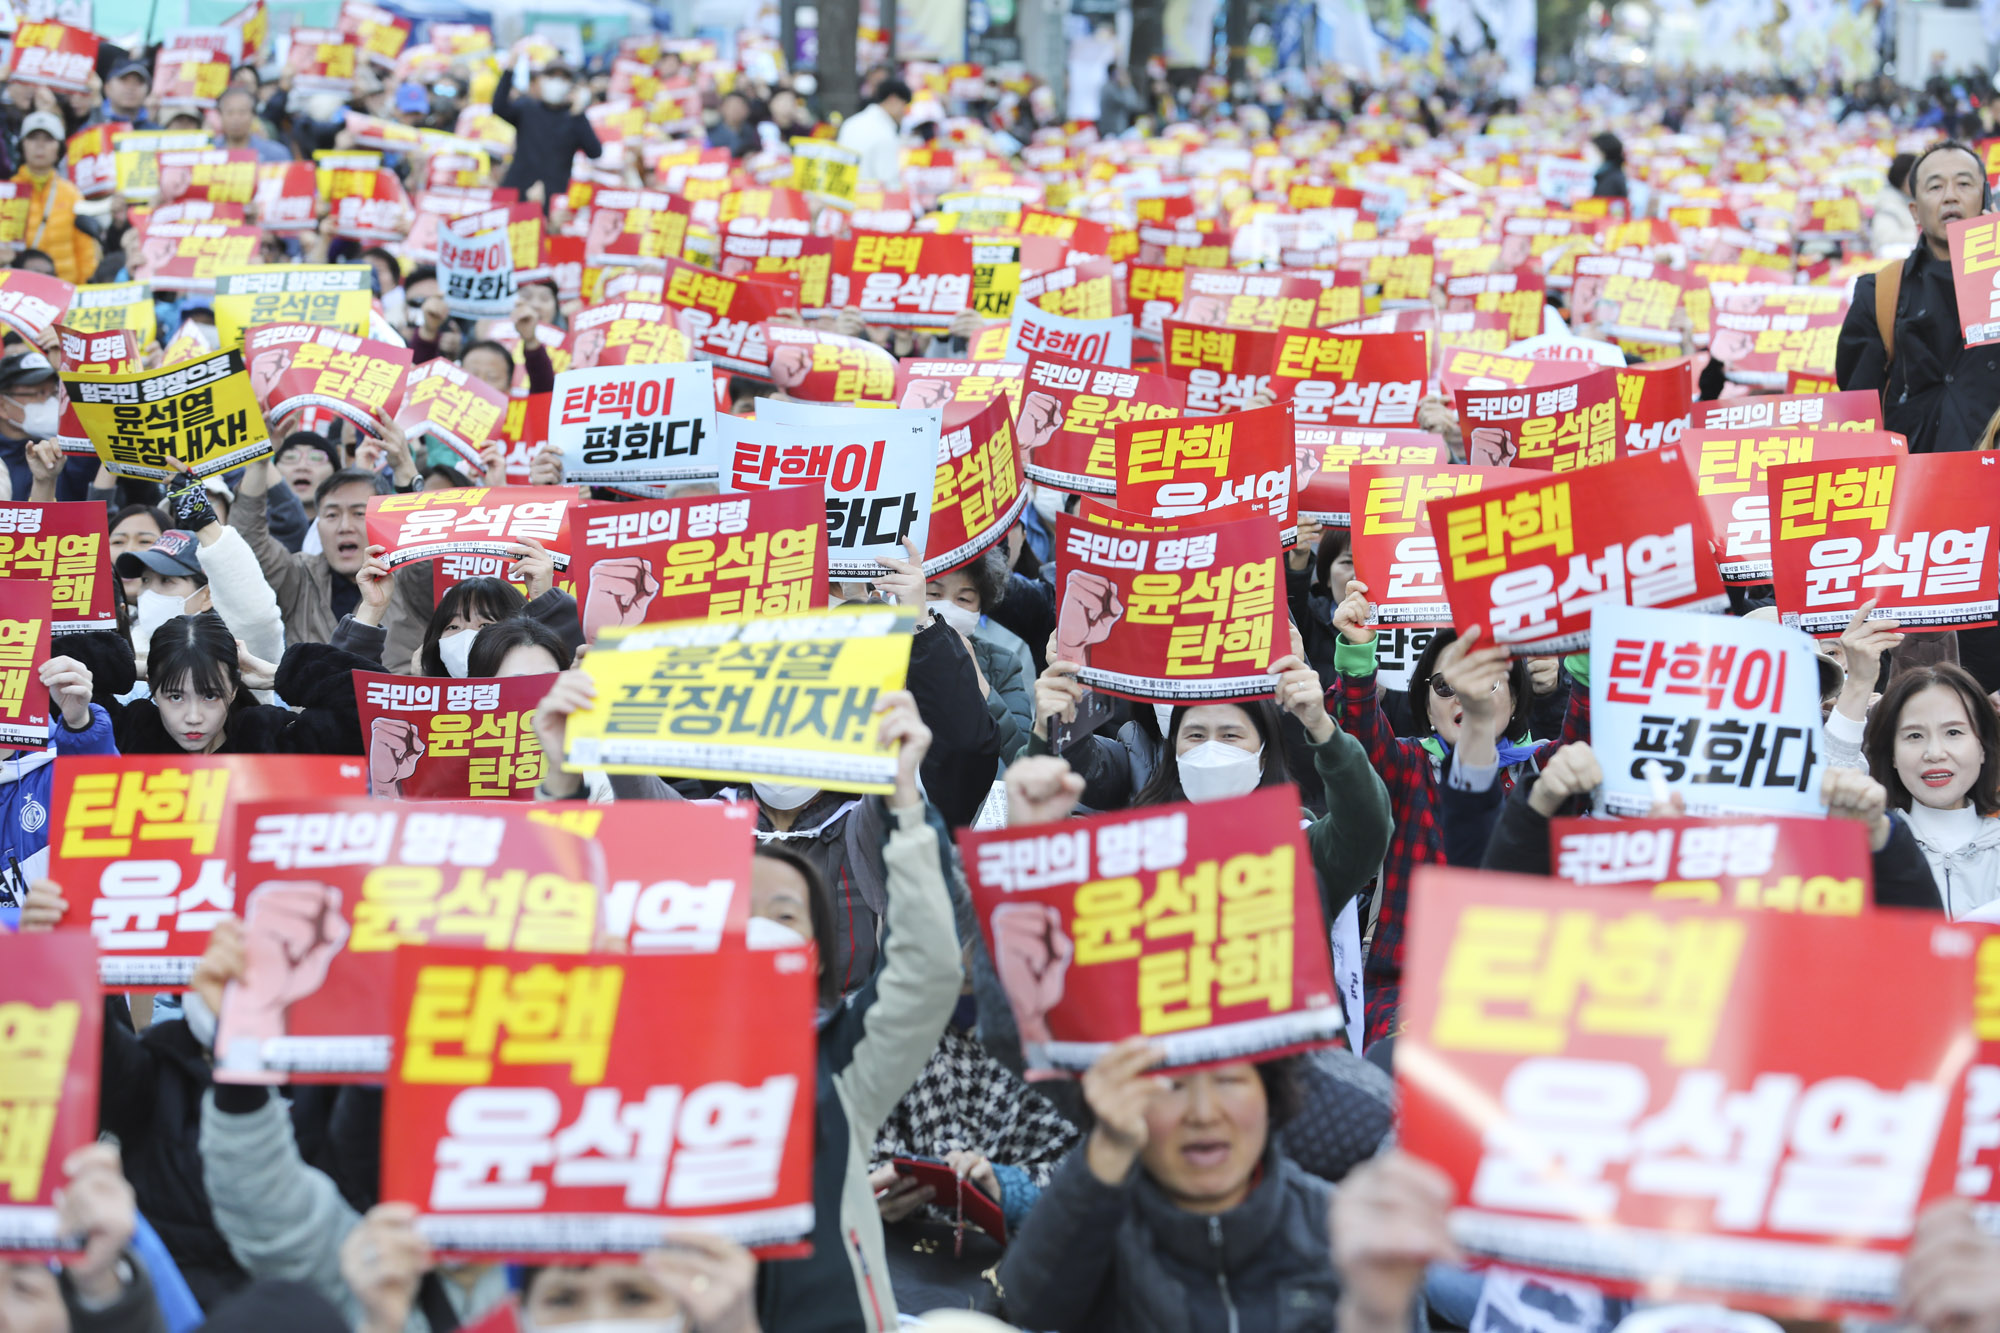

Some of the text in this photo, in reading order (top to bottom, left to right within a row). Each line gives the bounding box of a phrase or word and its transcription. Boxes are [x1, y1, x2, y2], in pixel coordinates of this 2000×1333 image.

[852, 235, 924, 274] 탄핵
[250, 294, 340, 323] 윤석열
[666, 267, 737, 316] 탄핵
[859, 272, 970, 312] 윤석열
[90, 333, 127, 362] 명령
[252, 325, 316, 349] 국민의
[681, 307, 769, 363] 윤석열
[1016, 320, 1110, 366] 탄핵이
[1171, 328, 1237, 373] 탄핵
[1276, 335, 1363, 380] 탄핵
[79, 354, 232, 404] 범국민 항쟁으로
[290, 342, 404, 388] 윤석열
[909, 362, 976, 377] 국민의
[954, 376, 1024, 404] 윤석
[1030, 360, 1140, 399] 국민의 명령
[1449, 351, 1534, 385] 탄핵
[113, 387, 215, 436] 윤석열
[313, 370, 387, 416] 탄핵
[561, 378, 675, 425] 탄핵이
[1294, 379, 1422, 425] 윤석열
[1467, 384, 1578, 421] 국민의 명령
[1705, 397, 1824, 429] 국민의 명령
[107, 409, 248, 467] 끝장내자!
[583, 418, 705, 464] 평화다
[1127, 422, 1234, 485] 탄핵
[1295, 430, 1336, 446] 민의
[1519, 397, 1616, 459] 윤석열
[731, 440, 887, 492] 탄핵이
[932, 418, 1014, 515] 윤석열
[1321, 445, 1438, 473] 윤석열
[1698, 436, 1814, 497] 탄핵
[377, 487, 491, 514] 탄핵
[396, 499, 568, 547] 윤석열
[586, 498, 750, 549] 국민의 명령
[826, 492, 919, 549] 화다
[961, 468, 1018, 540] 탄핵
[1780, 465, 1896, 540] 탄핵
[1066, 528, 1218, 572] 국민의 명령
[1447, 481, 1574, 582] 탄핵
[442, 555, 502, 581] 국민의
[662, 523, 819, 598] 윤석열
[1489, 522, 1698, 643] 윤석열
[1805, 526, 1990, 607] 윤석열
[52, 575, 95, 616] 핵
[1125, 556, 1277, 625] 윤석열
[1165, 612, 1274, 677] 탄핵
[366, 682, 500, 712] 국민의 명령
[1607, 639, 1788, 715] 탄핵이
[604, 684, 880, 743] 끝장내자!
[1630, 715, 1817, 793] 평화다
[59, 768, 231, 859] 탄핵
[249, 811, 397, 869] 국민의
[976, 829, 1091, 893] 국민의
[1557, 828, 1676, 885] 국민의
[348, 865, 600, 953] 윤석열
[1071, 844, 1297, 967] 윤석열
[1137, 928, 1295, 1036] 탄핵
[1432, 904, 1746, 1067] 탄핵
[400, 964, 625, 1086] 탄핵
[429, 1074, 799, 1211] 윤석열
[1470, 1056, 1948, 1240] 윤석열
